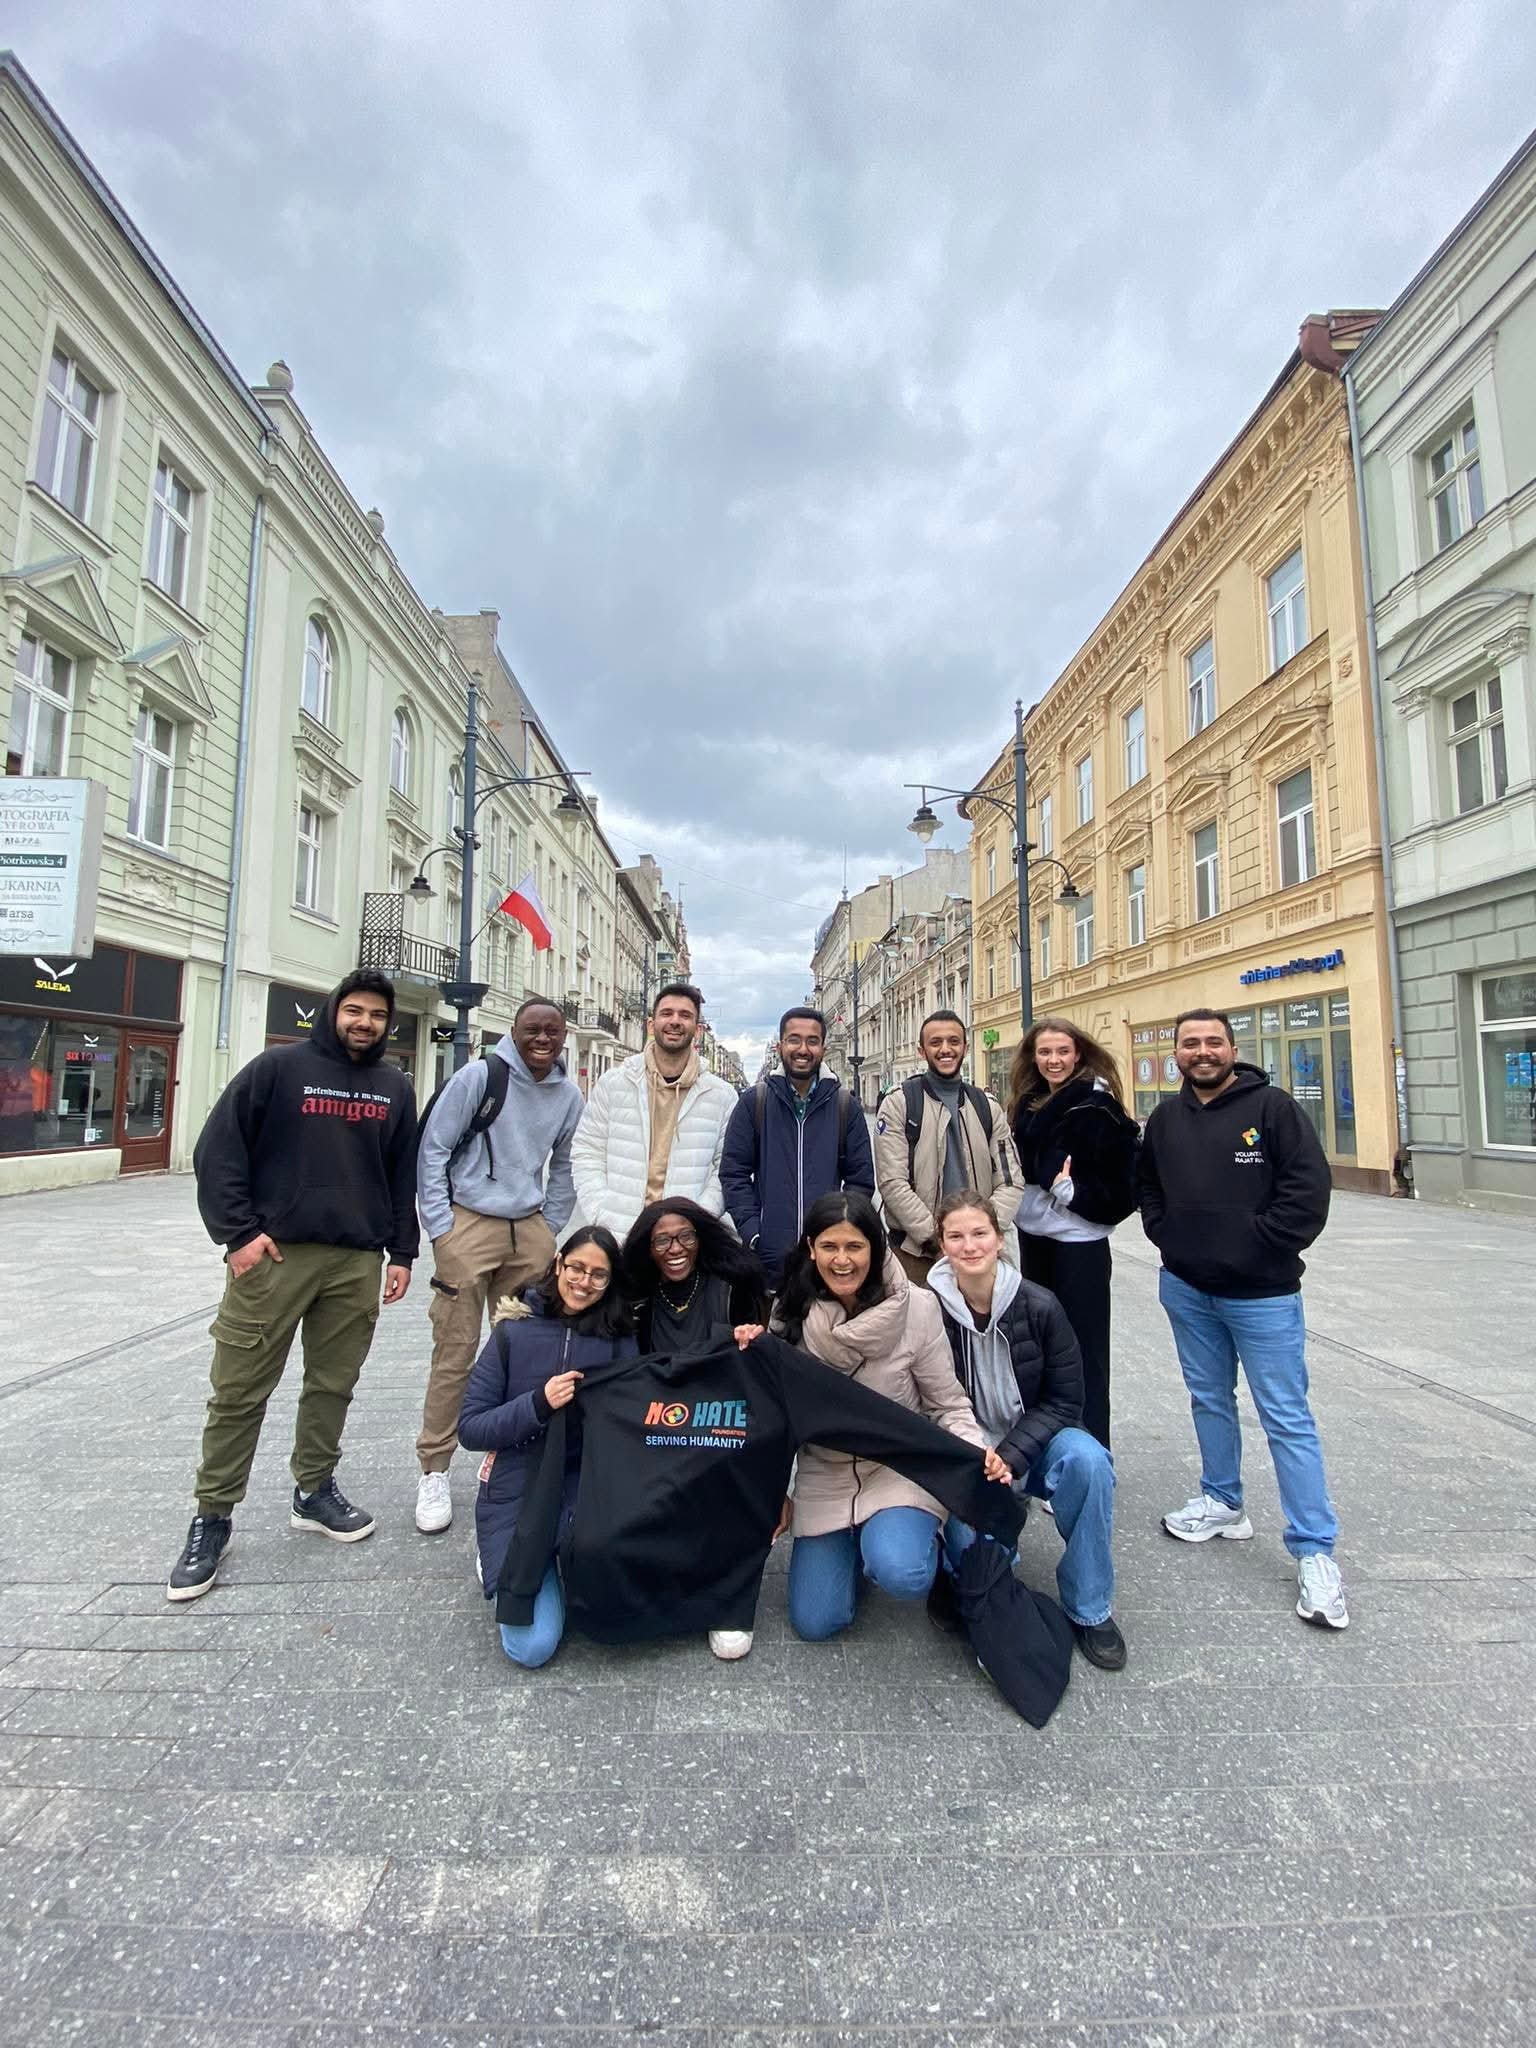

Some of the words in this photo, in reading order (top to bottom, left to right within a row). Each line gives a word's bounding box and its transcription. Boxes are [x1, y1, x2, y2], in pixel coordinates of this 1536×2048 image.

[0, 809, 70, 821] TOGRAFIA
[57, 857, 63, 866] 4
[35, 980, 71, 992] SALEWA
[303, 1086, 350, 1098] Defendemos
[301, 1097, 389, 1121] amigos
[644, 1401, 689, 1427] NO
[692, 1400, 747, 1428] HATE
[711, 1428, 746, 1437] FOUNDATION
[645, 1435, 687, 1446] SERVING
[689, 1437, 746, 1449] HUMANITY
